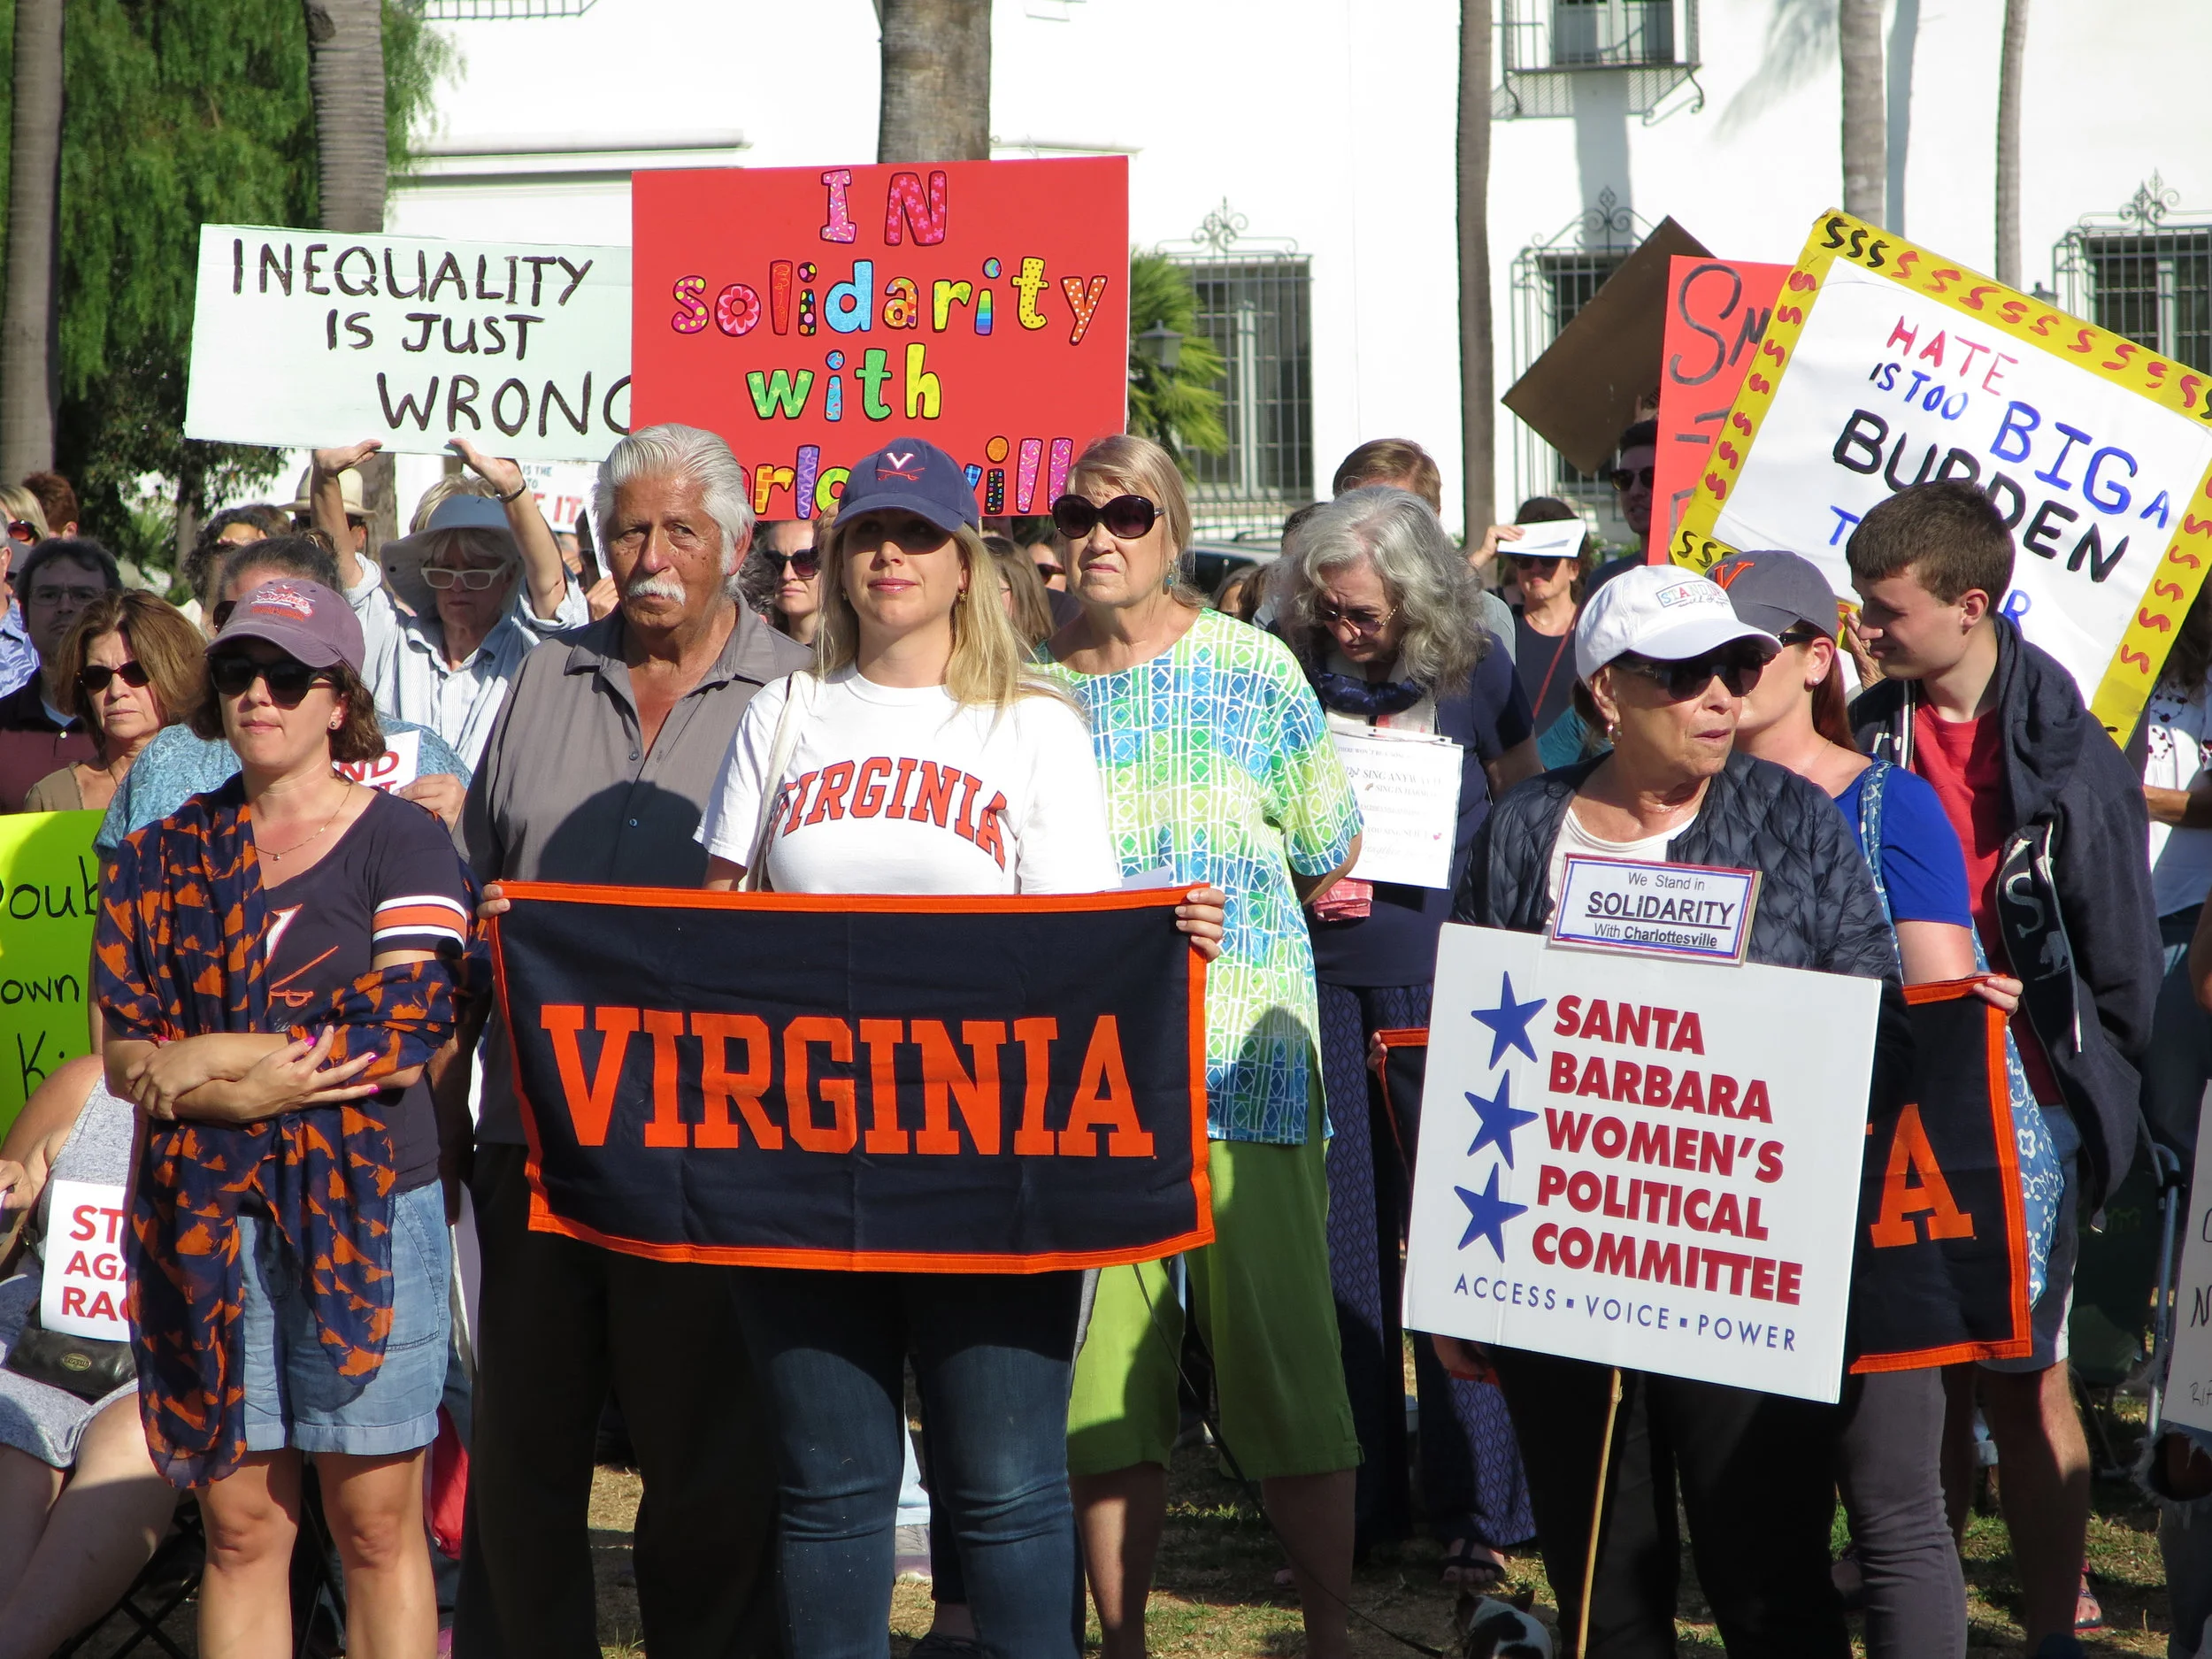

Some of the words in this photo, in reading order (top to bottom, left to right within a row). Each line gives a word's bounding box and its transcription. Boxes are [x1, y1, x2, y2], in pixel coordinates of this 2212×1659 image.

[819, 169, 948, 246] IN
[233, 238, 594, 306] INEQUALITY
[672, 257, 1109, 345] solidarity
[326, 310, 373, 350] IS
[402, 312, 545, 360] JUST
[1886, 316, 2018, 396] HATE
[745, 342, 942, 421] with
[1869, 363, 1901, 390] IS
[1903, 370, 1969, 420] TOO
[1989, 401, 2138, 515] BIG
[2139, 489, 2170, 529] A
[553, 495, 583, 524] IT
[1586, 891, 1735, 926] SOLIDARITY
[1628, 872, 1647, 887] We
[1655, 874, 1691, 890] Stand
[1694, 878, 1705, 891] in
[1594, 923, 1620, 939] With
[1624, 926, 1717, 948] Charlottesville
[1553, 995, 1705, 1056] SANTA
[540, 1004, 1157, 1158] VIRGINIA
[1548, 1051, 1773, 1124] BARBARA
[1544, 1107, 1785, 1183] WOMEN'S
[1866, 1104, 1975, 1248] A
[1537, 1164, 1770, 1241] POLITICAL
[1532, 1223, 1803, 1306] COMMITTEE
[1454, 1272, 1556, 1310] ACCESS
[1586, 1294, 1670, 1330] VOICE
[1698, 1315, 1796, 1352] POWER
